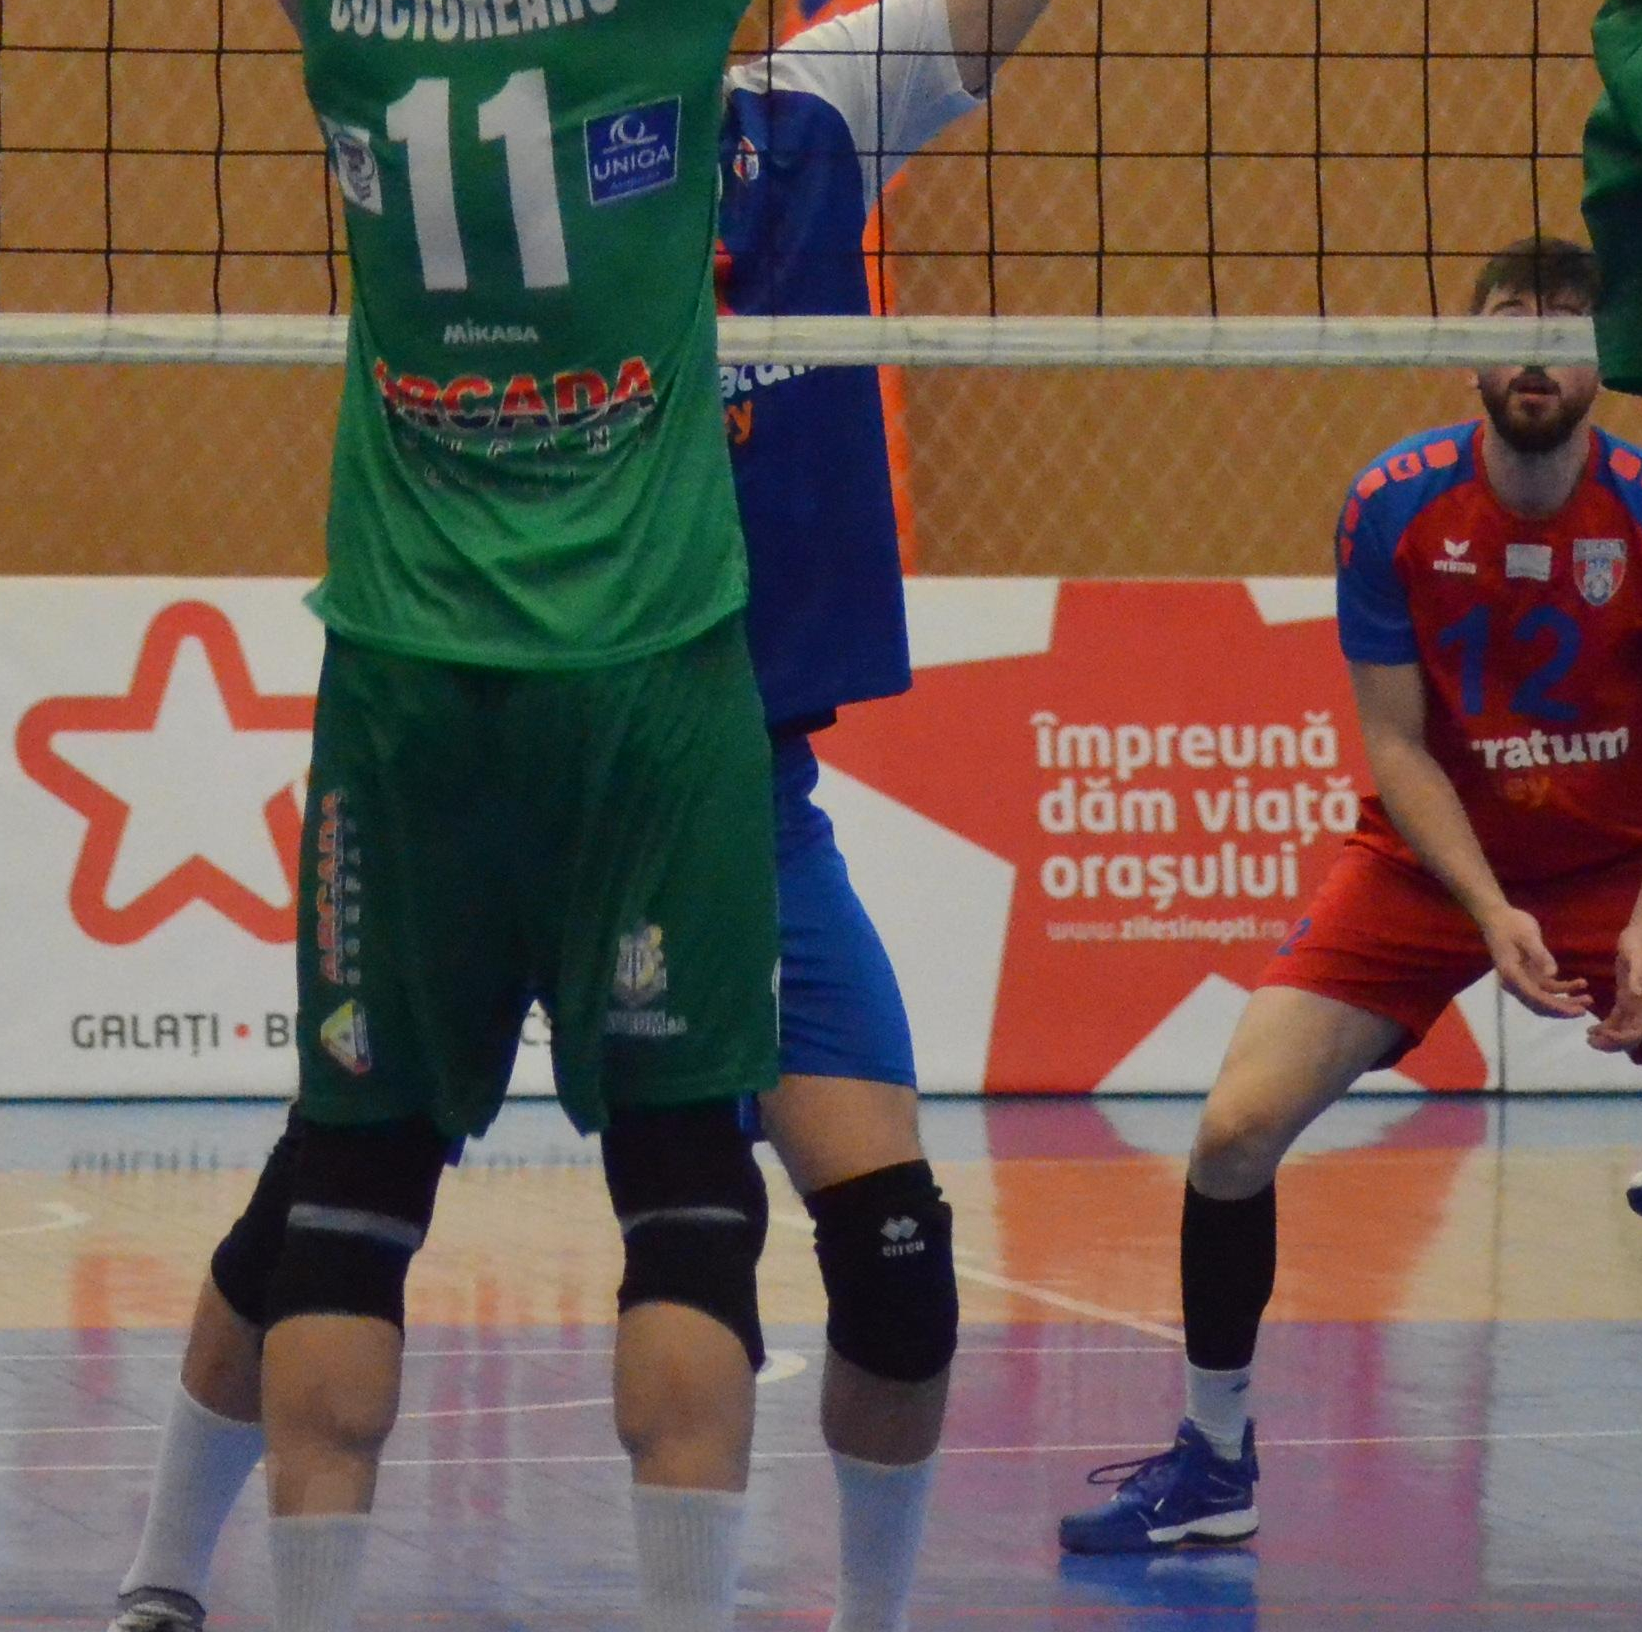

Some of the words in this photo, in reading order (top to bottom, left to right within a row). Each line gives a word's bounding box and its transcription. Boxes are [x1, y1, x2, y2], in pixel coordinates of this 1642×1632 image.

[386, 68, 569, 290] 11
[594, 145, 671, 181] UNIQA
[1439, 604, 1583, 720] 12
[1030, 711, 1340, 782] împreună
[1038, 776, 1178, 834] dăm
[1193, 775, 1359, 845] viață
[1041, 842, 1299, 911] orașului
[71, 1012, 221, 1057] GALAȚI
